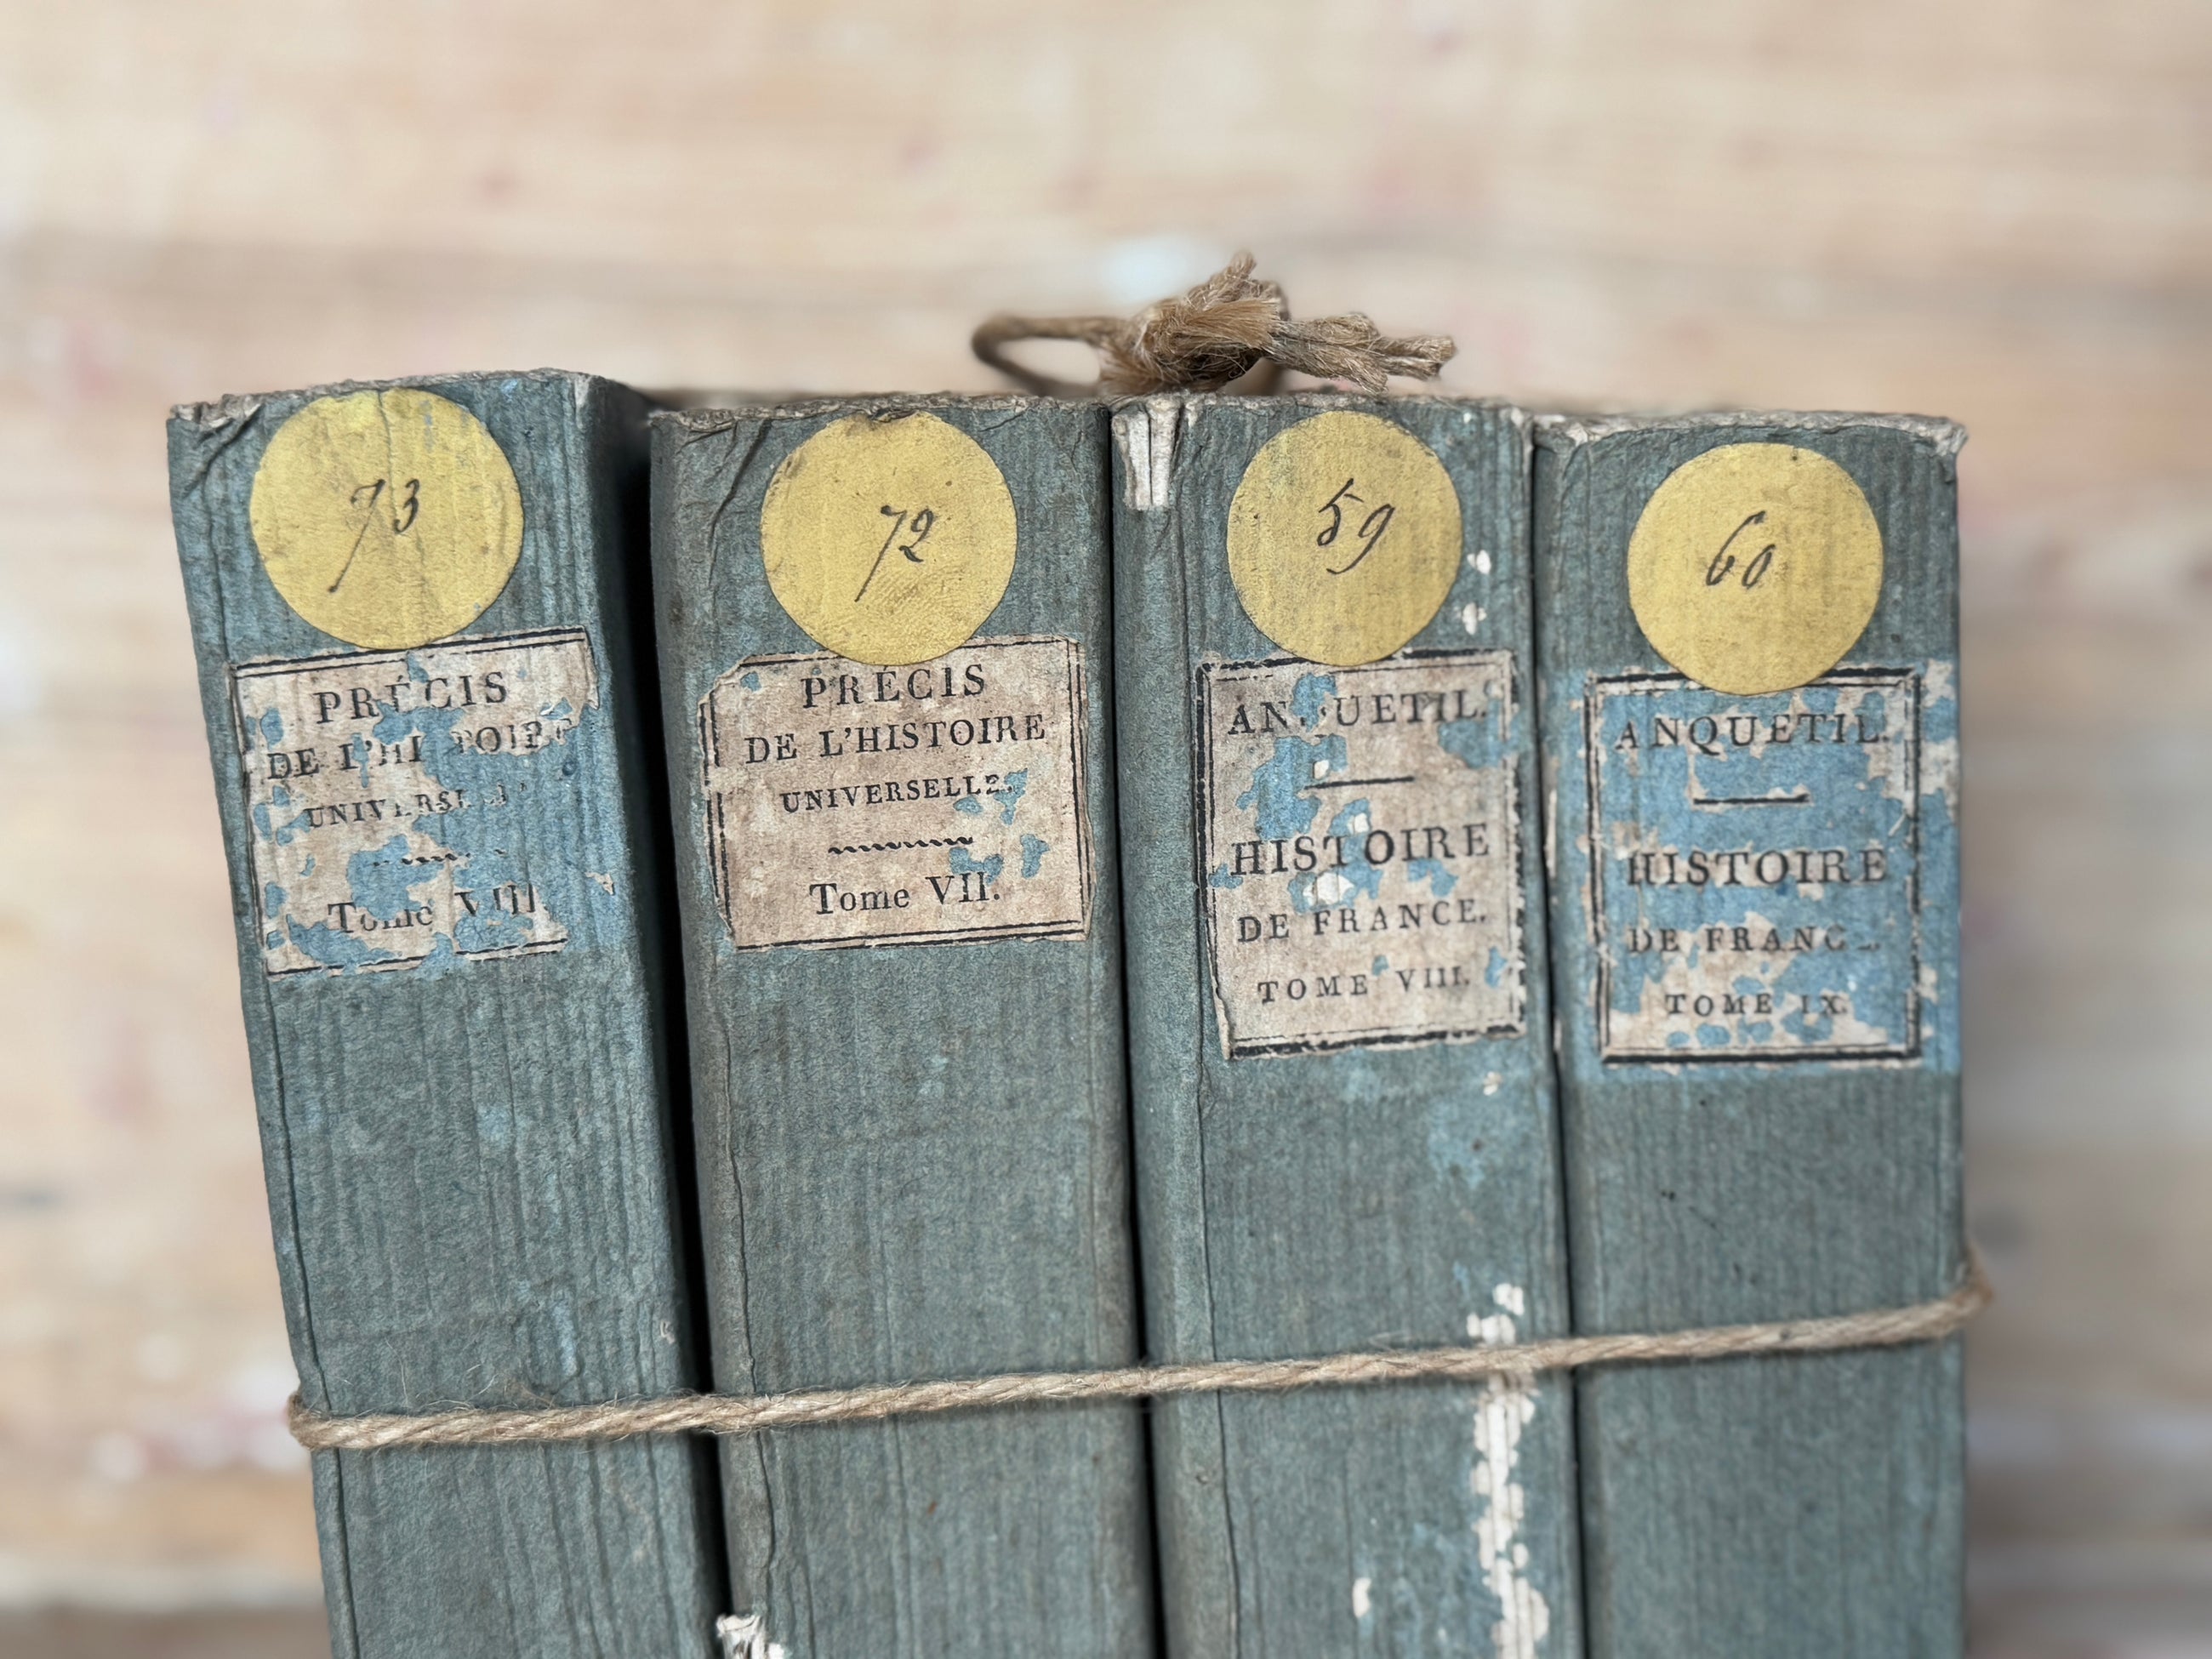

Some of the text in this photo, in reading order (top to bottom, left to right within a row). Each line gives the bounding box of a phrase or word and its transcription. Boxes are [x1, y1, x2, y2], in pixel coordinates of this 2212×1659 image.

[327, 478, 421, 593] 73
[1316, 477, 1395, 575] 59
[854, 504, 940, 602] 72
[1705, 510, 1777, 590] 60
[801, 664, 986, 709] PRÉCIS
[1228, 689, 1488, 738] ANUETIL.
[744, 713, 1046, 764] DE L'HISTOIRE
[266, 748, 321, 780] DE
[1230, 823, 1491, 877] HISTOIRE
[1628, 847, 1888, 887] HISTOIRE
[809, 871, 1001, 915] Tome VII.
[1238, 898, 1487, 944] DE FRANCE.
[1628, 923, 1881, 954] DE FRANC
[1257, 975, 1369, 1004] TOME
[1664, 993, 1773, 1018] TOME
